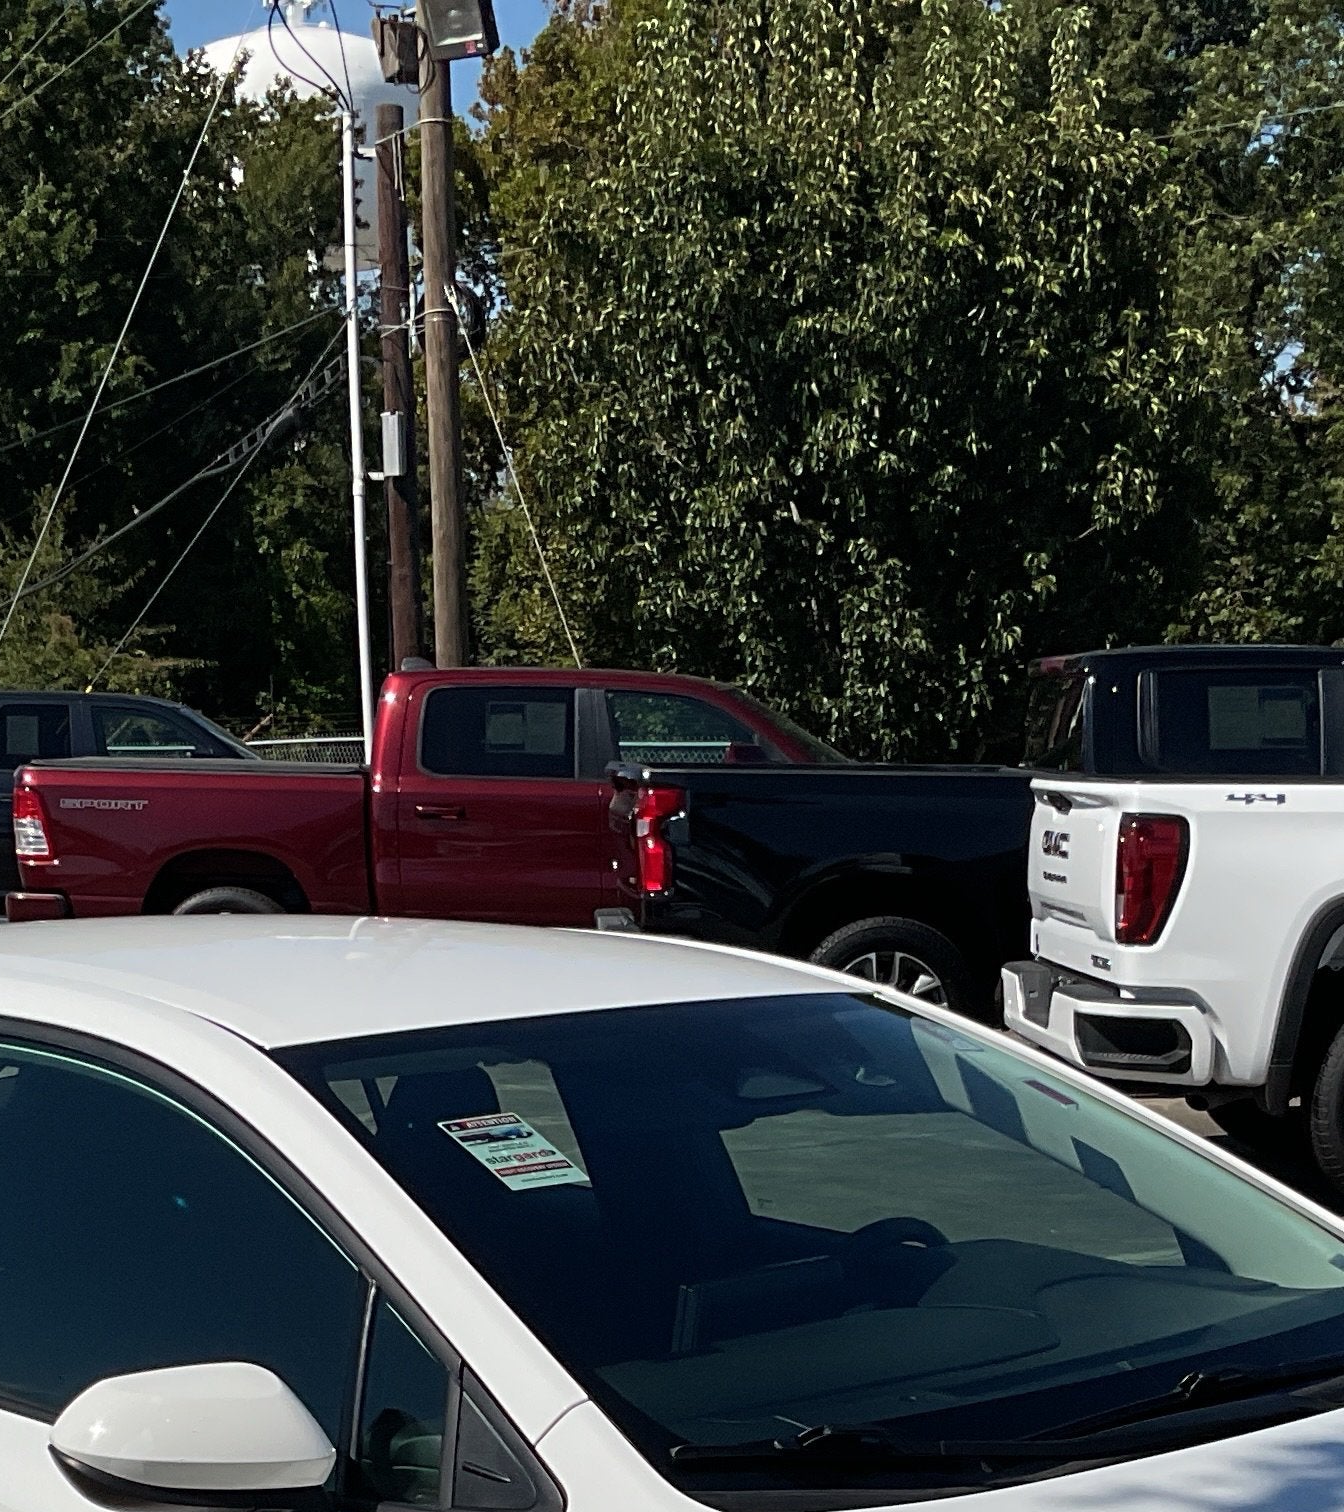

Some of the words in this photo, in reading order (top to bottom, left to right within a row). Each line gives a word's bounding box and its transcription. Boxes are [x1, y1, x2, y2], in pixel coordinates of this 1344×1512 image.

[59, 798, 149, 811] SPORT
[1041, 829, 1071, 860] GMC
[466, 1115, 518, 1129] ATTENTION
